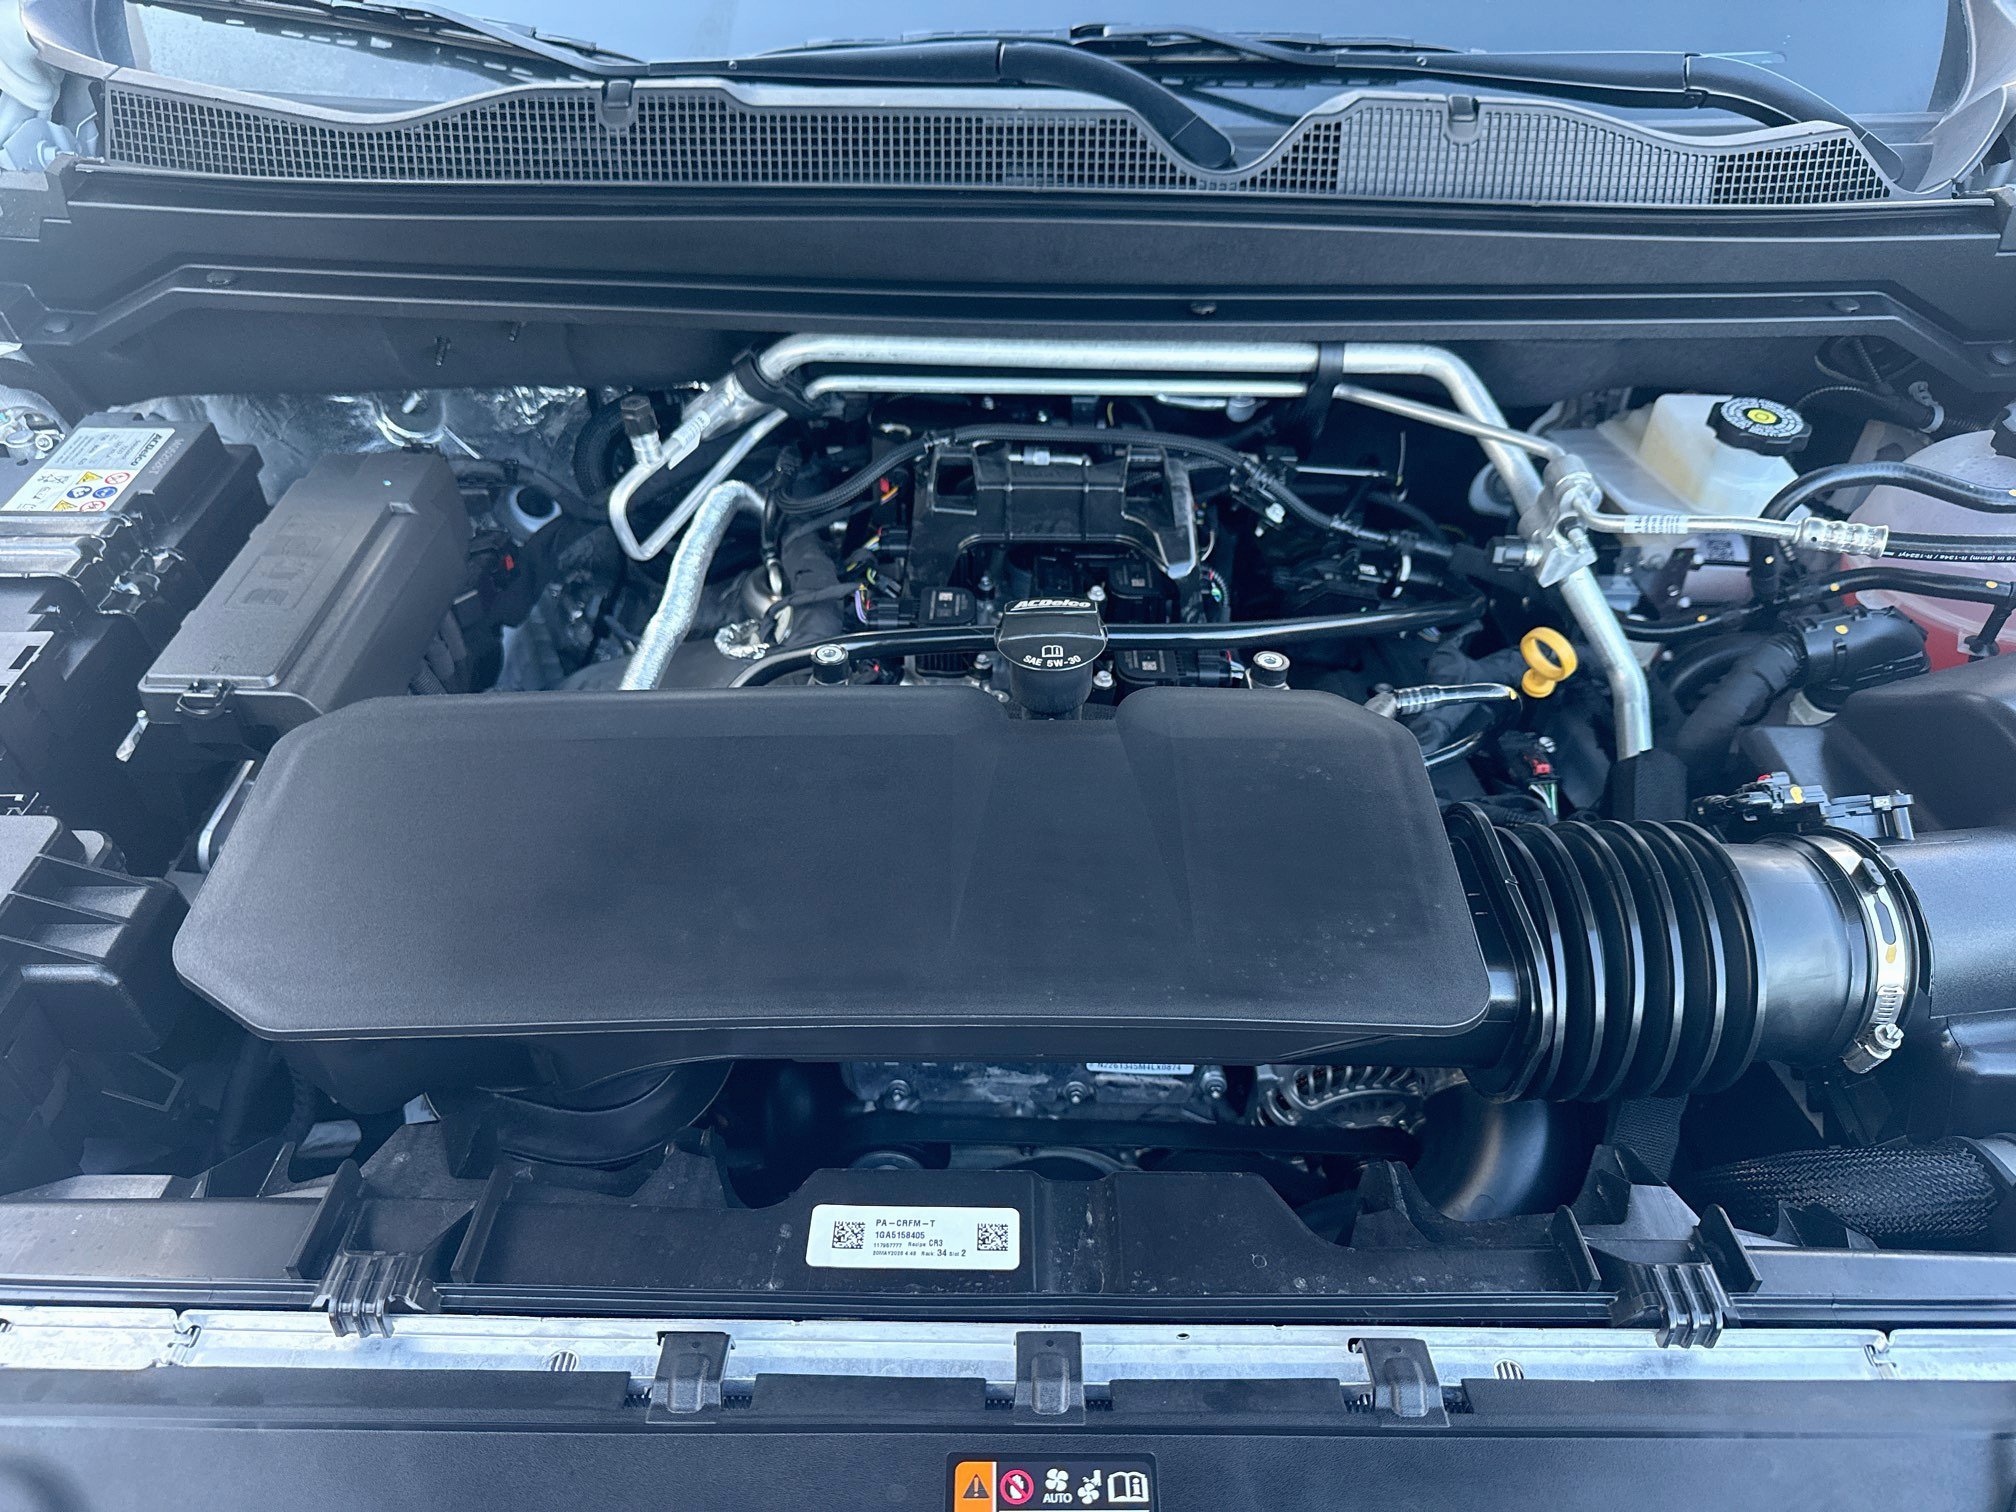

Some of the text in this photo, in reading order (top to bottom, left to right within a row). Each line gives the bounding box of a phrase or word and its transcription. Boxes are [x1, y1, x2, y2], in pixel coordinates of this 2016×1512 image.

[130, 432, 163, 467] ACDelco
[1013, 598, 1091, 610] ACDelco
[1023, 655, 1043, 666] SAE
[875, 1219, 936, 1228] PA-CRFM-T
[875, 1230, 926, 1239] 1GA5158405
[928, 1239, 944, 1247] CR3
[937, 1248, 947, 1257] 34
[961, 1248, 967, 1257] 2
[1042, 1492, 1073, 1504] AUTO
